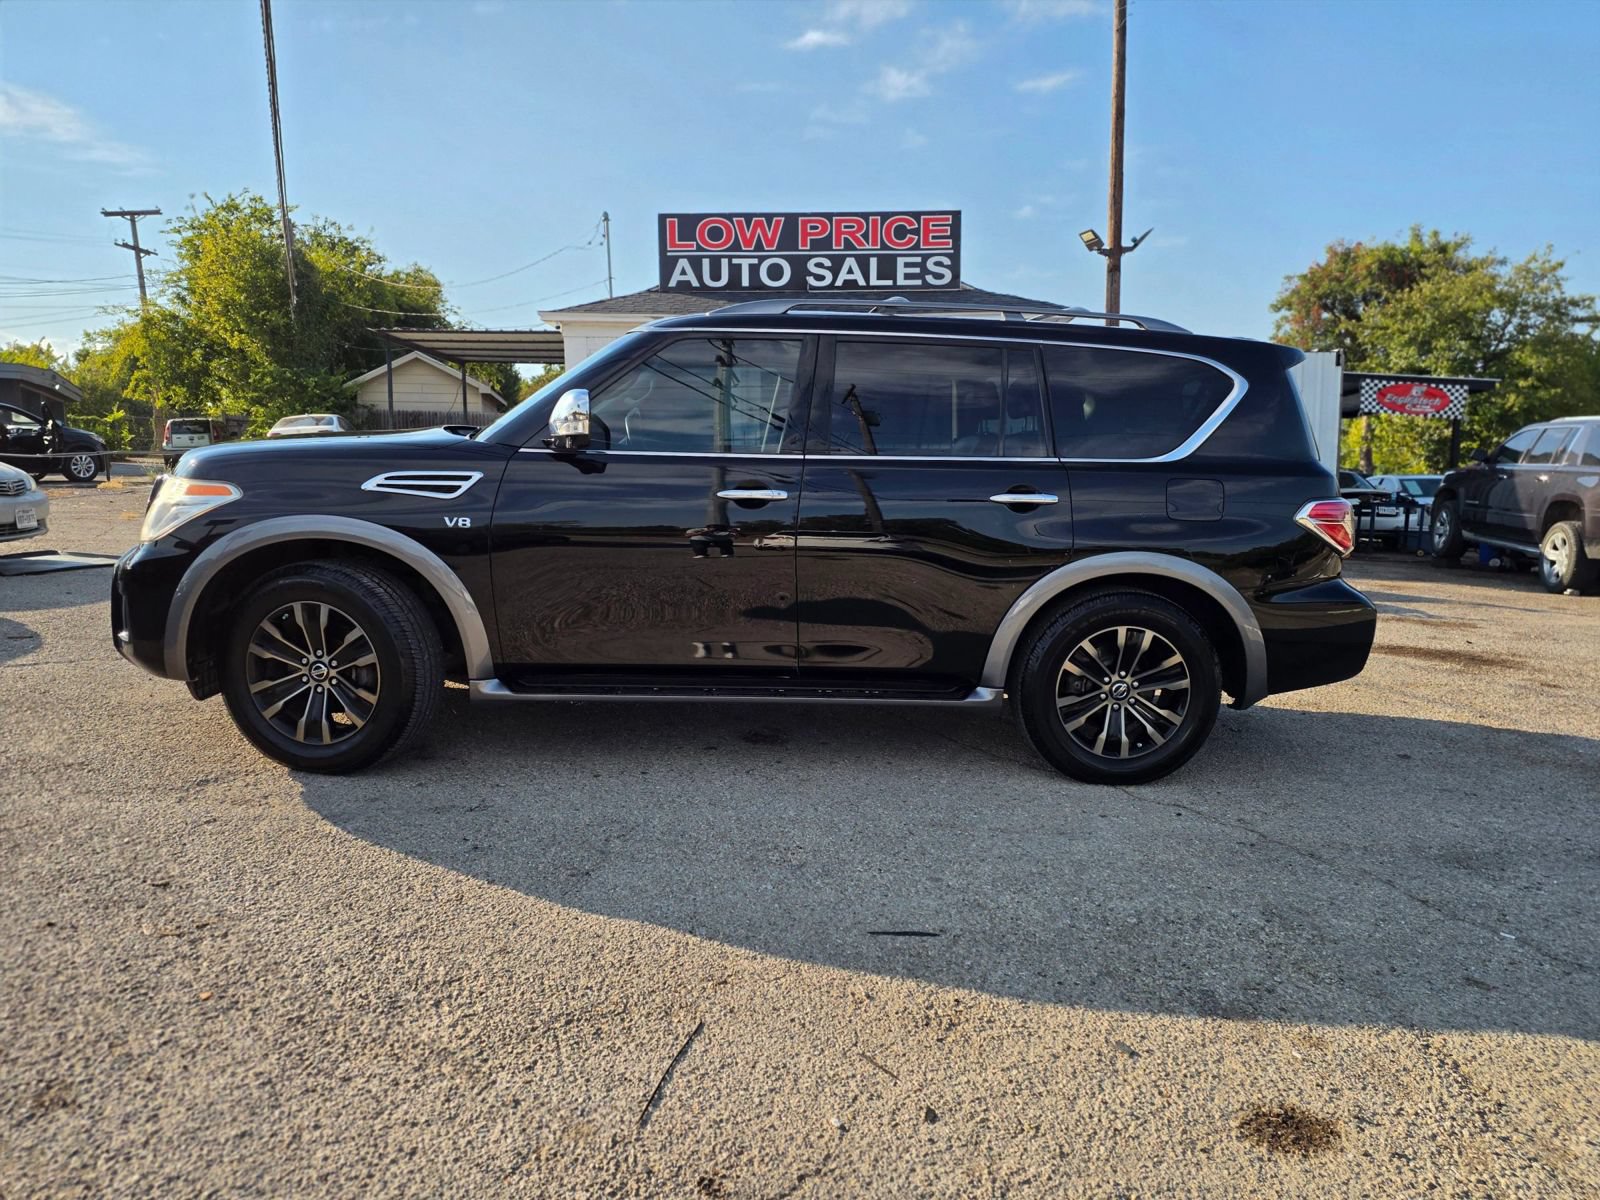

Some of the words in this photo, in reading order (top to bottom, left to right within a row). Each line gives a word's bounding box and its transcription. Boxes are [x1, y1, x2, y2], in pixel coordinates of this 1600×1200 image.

[667, 217, 784, 250] LOW
[798, 215, 952, 249] PRICE
[668, 258, 791, 288] AUTO
[807, 256, 952, 287] SALES
[443, 516, 471, 529] V8
